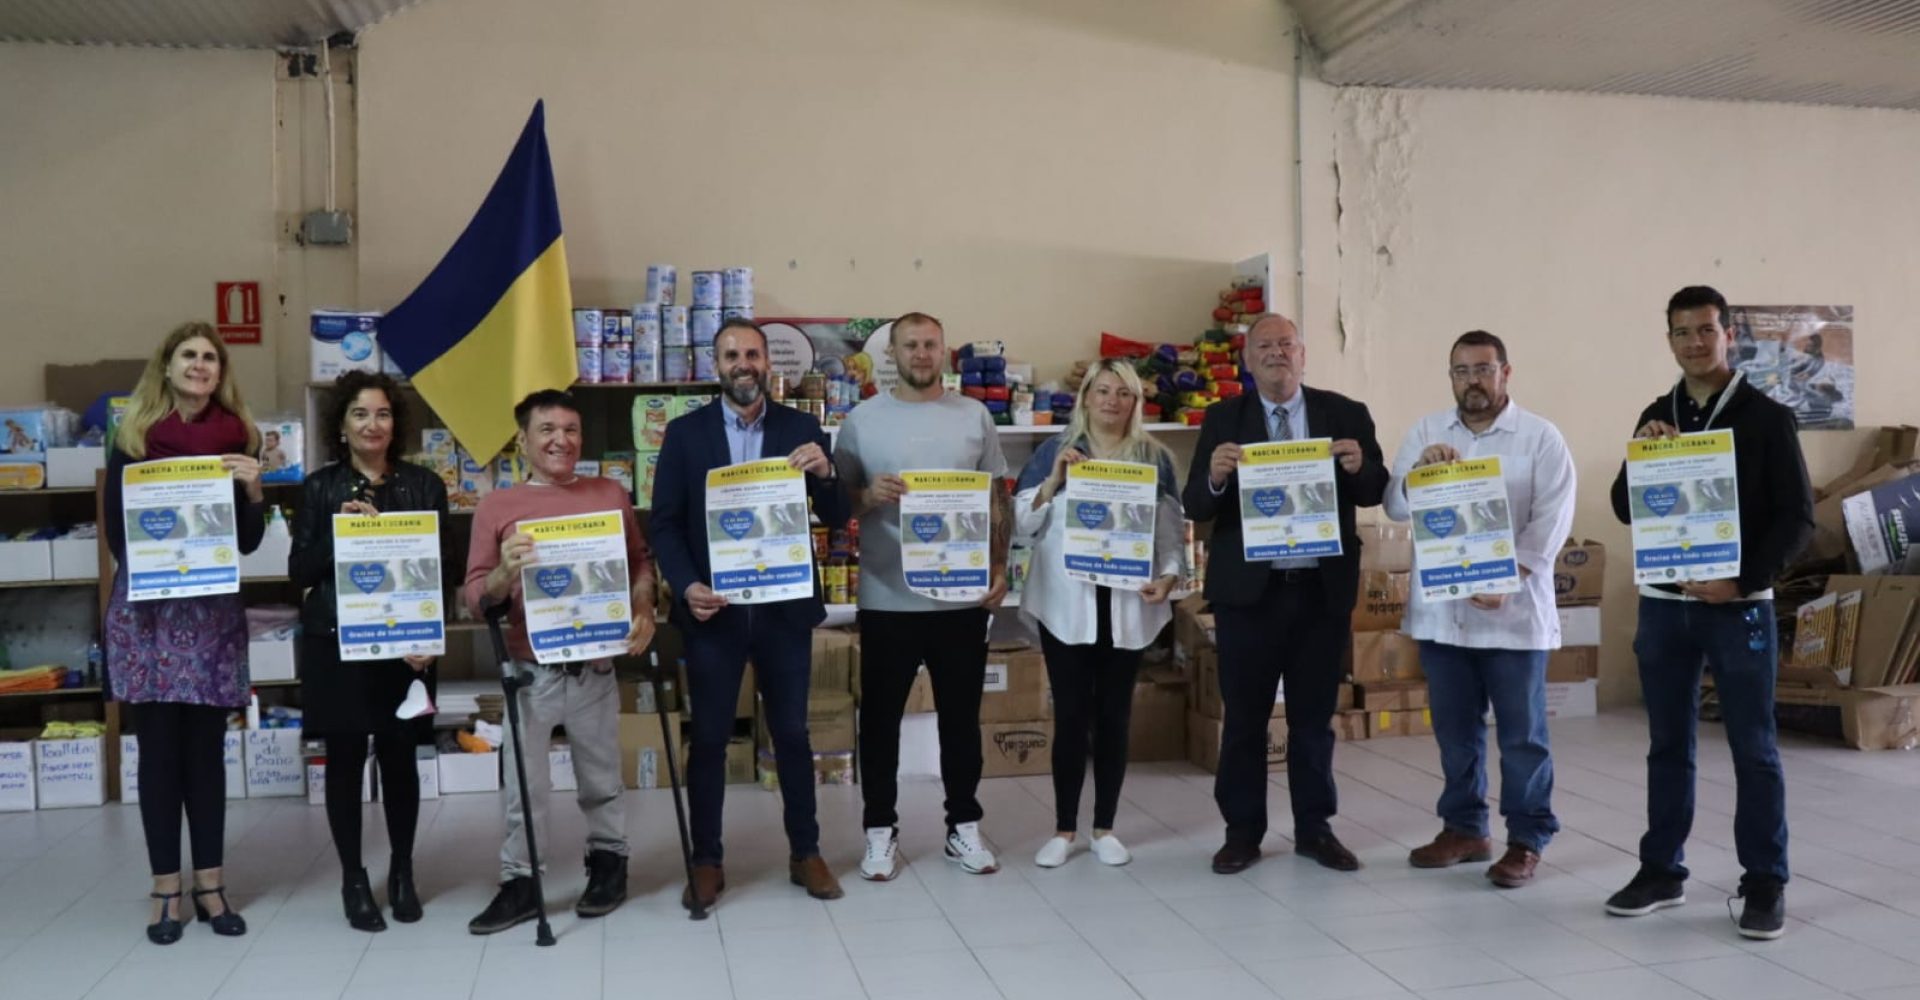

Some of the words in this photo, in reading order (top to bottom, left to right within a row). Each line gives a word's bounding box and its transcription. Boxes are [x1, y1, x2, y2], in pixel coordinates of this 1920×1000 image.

[1642, 443, 1673, 452] MARCHA
[1681, 439, 1715, 448] UCRANIA
[756, 465, 786, 473] UCRANIA
[1421, 470, 1448, 478] MARCHA
[1456, 464, 1486, 473] UCRANIA
[573, 521, 605, 530] UCRANIA
[758, 572, 774, 580] todo
[377, 630, 386, 638] de
[388, 628, 405, 636] todo
[539, 636, 563, 644] Gracias
[576, 631, 592, 639] todo
